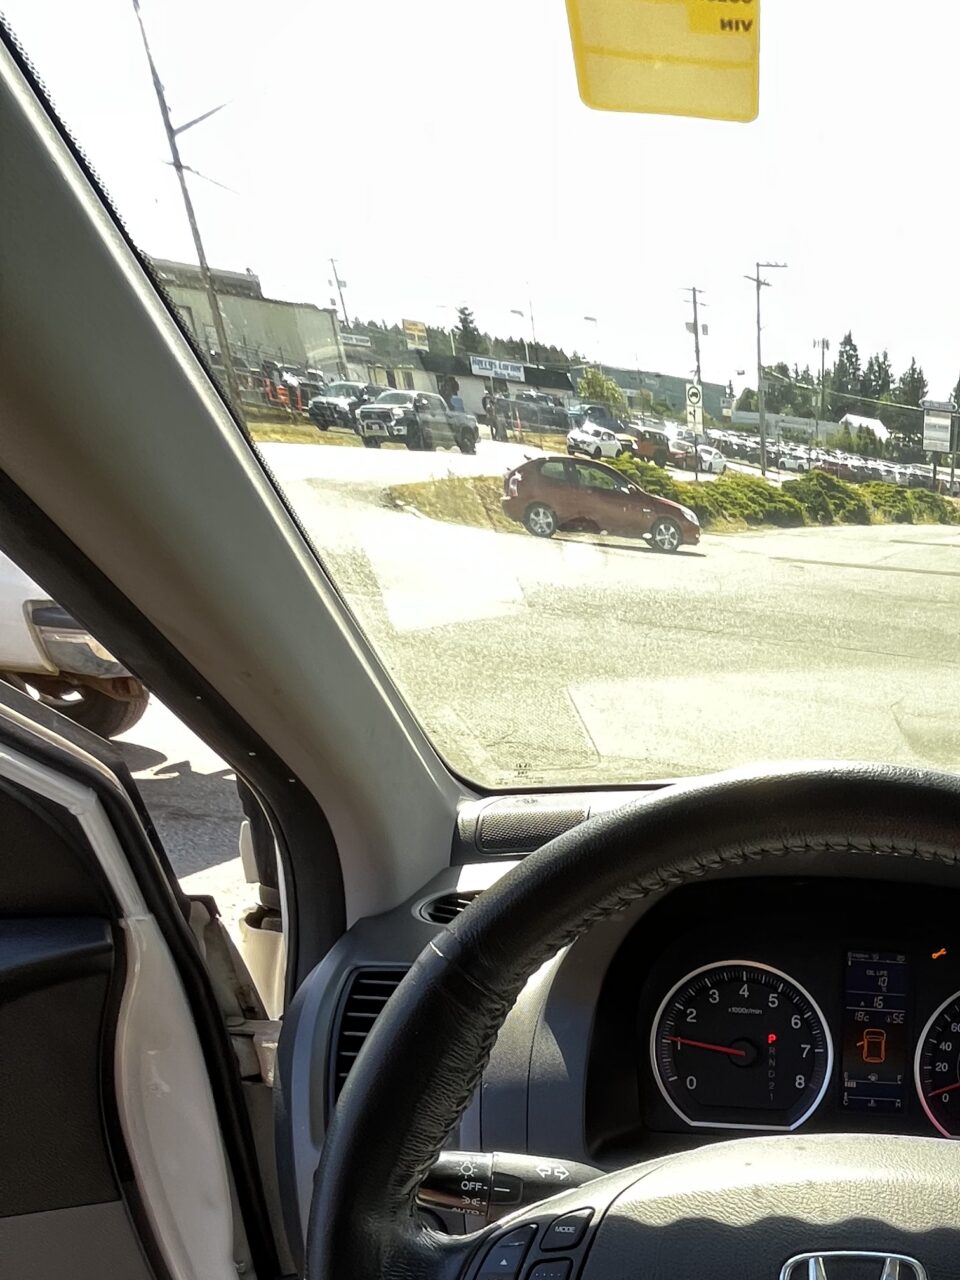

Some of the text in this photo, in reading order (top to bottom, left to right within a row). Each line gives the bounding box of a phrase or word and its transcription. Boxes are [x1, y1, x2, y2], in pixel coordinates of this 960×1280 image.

[709, 989, 720, 1003] 3
[739, 984, 749, 998] 4
[768, 994, 779, 1008] 5
[686, 1009, 697, 1022] 2
[791, 1015, 801, 1029] 6
[768, 1034, 777, 1044] P
[801, 1045, 811, 1058] 7
[939, 1041, 952, 1051] 40
[935, 1062, 948, 1072] 20
[686, 1076, 697, 1089] 0
[795, 1075, 805, 1088] 8
[942, 1093, 949, 1102] 0
[461, 1180, 483, 1190] OFF
[451, 1207, 481, 1216] AUTO
[555, 1226, 575, 1234] MODE
